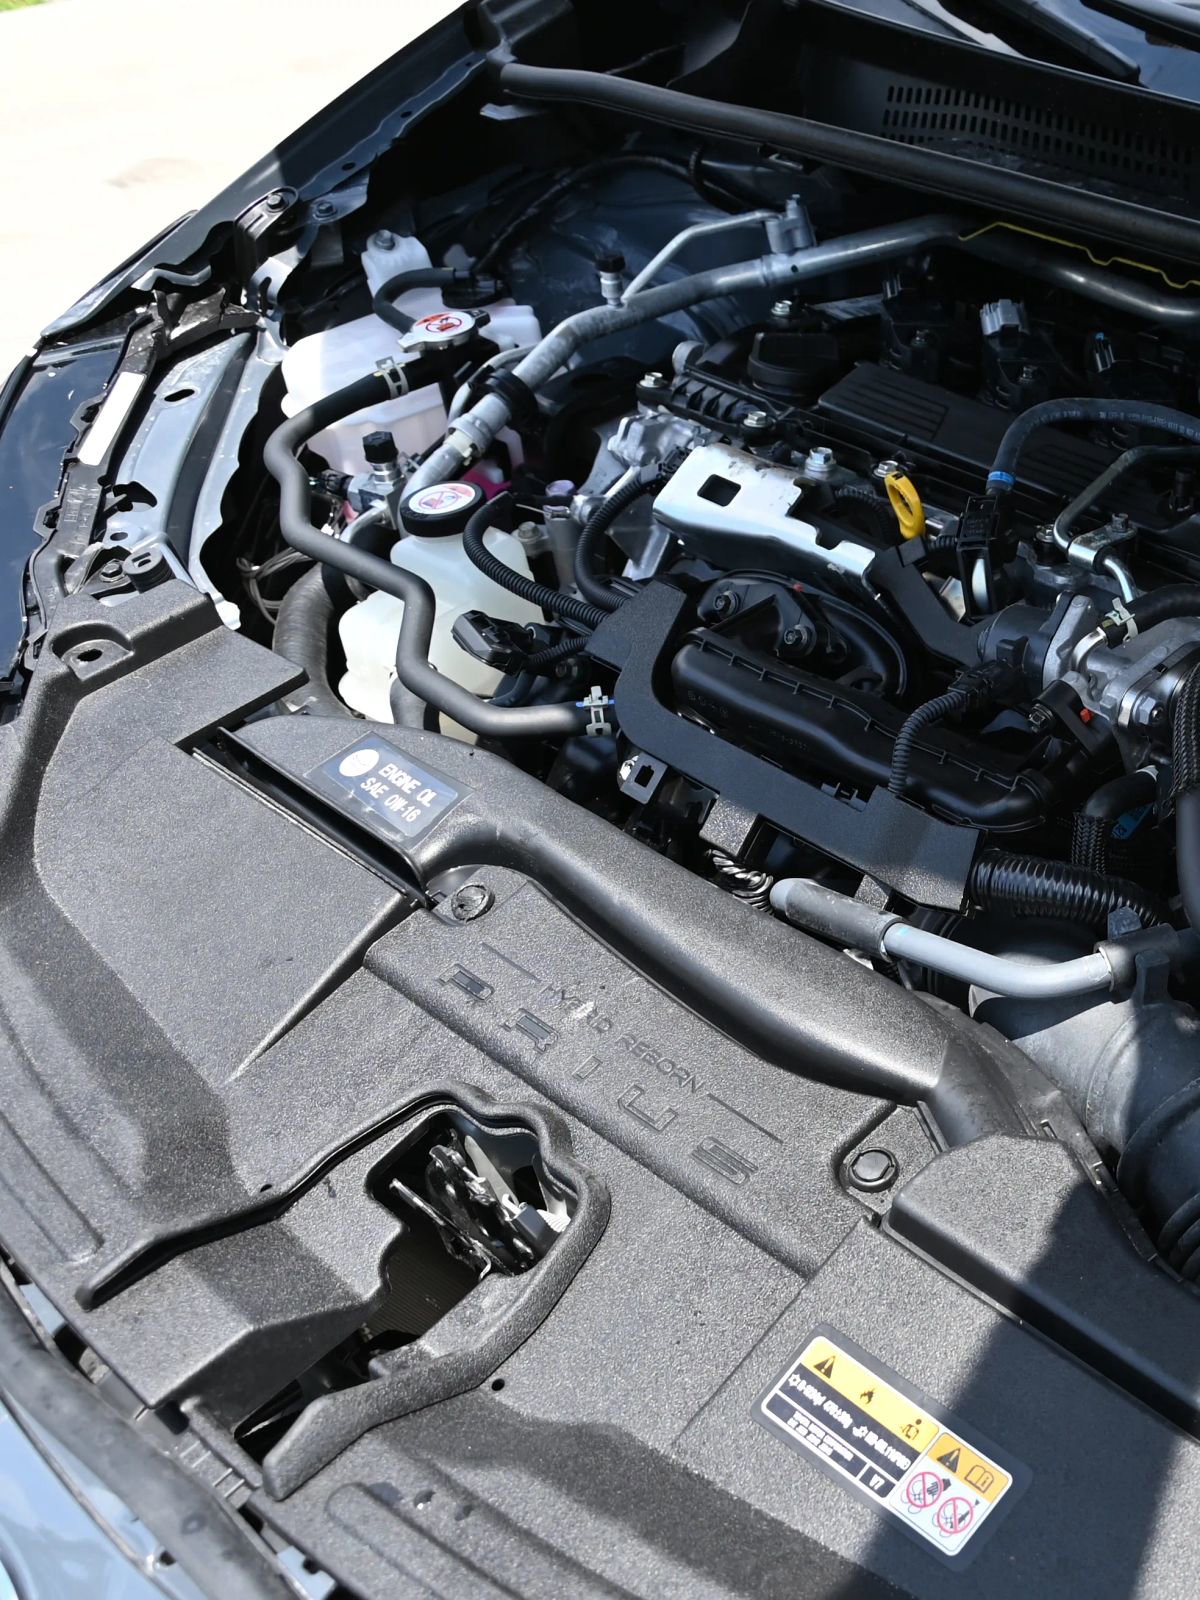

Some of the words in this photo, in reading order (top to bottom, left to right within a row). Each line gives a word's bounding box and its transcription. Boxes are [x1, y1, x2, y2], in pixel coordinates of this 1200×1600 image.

[361, 778, 389, 798] SAE
[384, 795, 421, 822] 0W-16
[378, 764, 420, 794] ENGINE
[417, 789, 437, 807] OIL
[439, 964, 758, 1185] PRIUS
[541, 984, 614, 1034] HYBRID
[616, 1033, 704, 1093] REBORN
